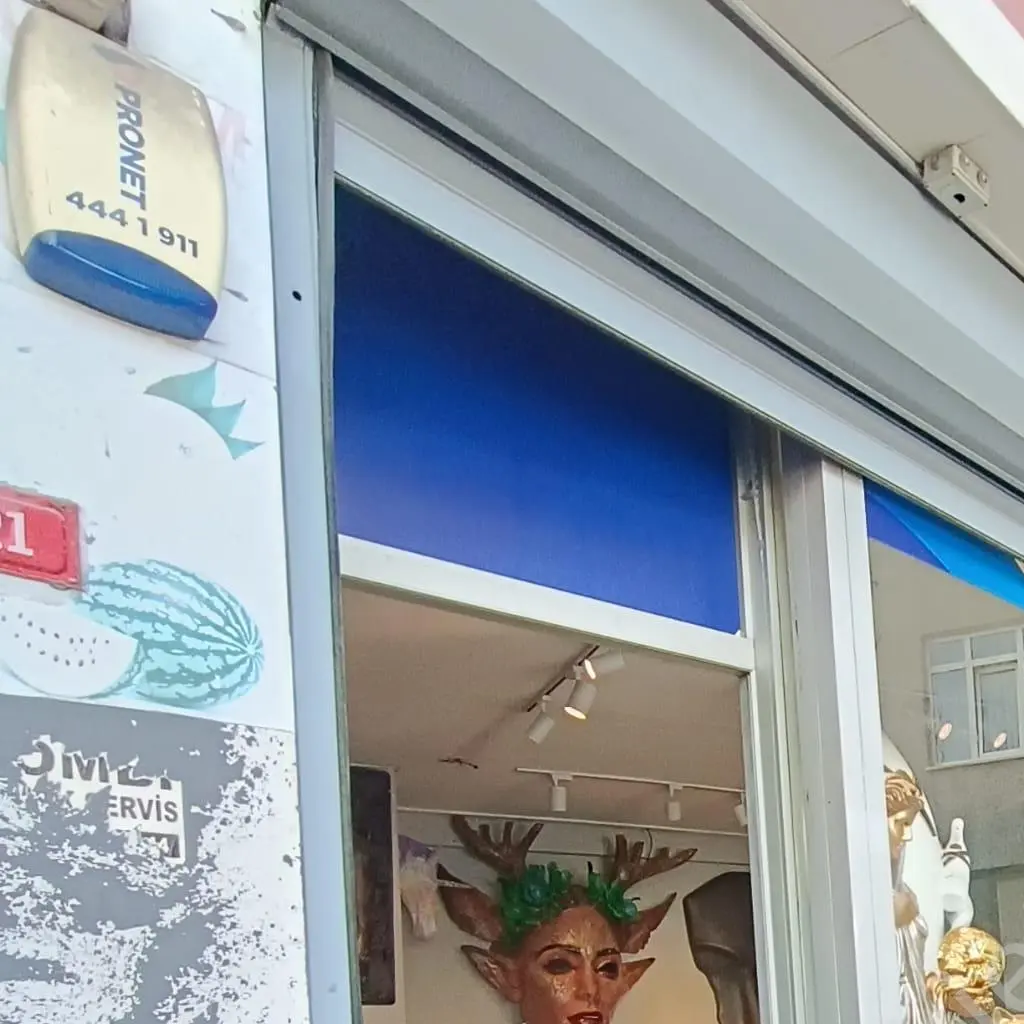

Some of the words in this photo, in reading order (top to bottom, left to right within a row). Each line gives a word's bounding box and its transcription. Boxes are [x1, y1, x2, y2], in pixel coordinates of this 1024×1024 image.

[115, 82, 147, 210] PRONET
[66, 191, 128, 229] 444
[136, 216, 149, 237] 1
[159, 226, 198, 259] 911
[0, 510, 34, 557] 1
[107, 794, 179, 823] ERVİS
